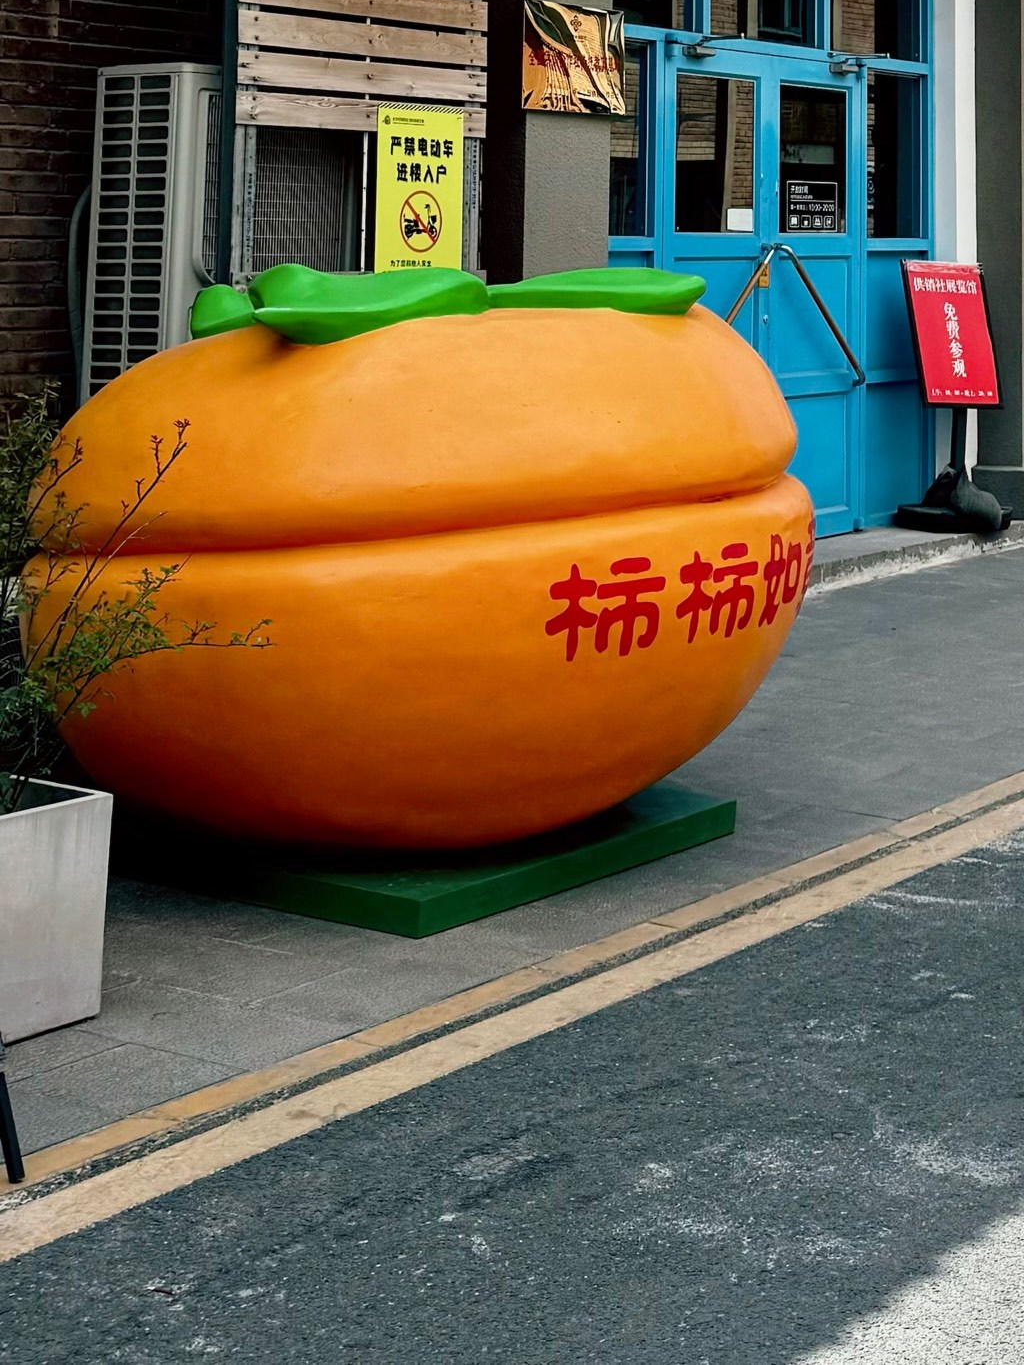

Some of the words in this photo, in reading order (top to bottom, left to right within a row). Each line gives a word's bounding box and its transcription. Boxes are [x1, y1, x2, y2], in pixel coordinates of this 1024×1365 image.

[390, 136, 453, 158] 严禁电动车
[396, 162, 447, 184] 进楼入户
[913, 277, 978, 295] 供销社展览馆
[943, 302, 967, 378] 免费参观
[545, 517, 815, 662] 柿柿如
